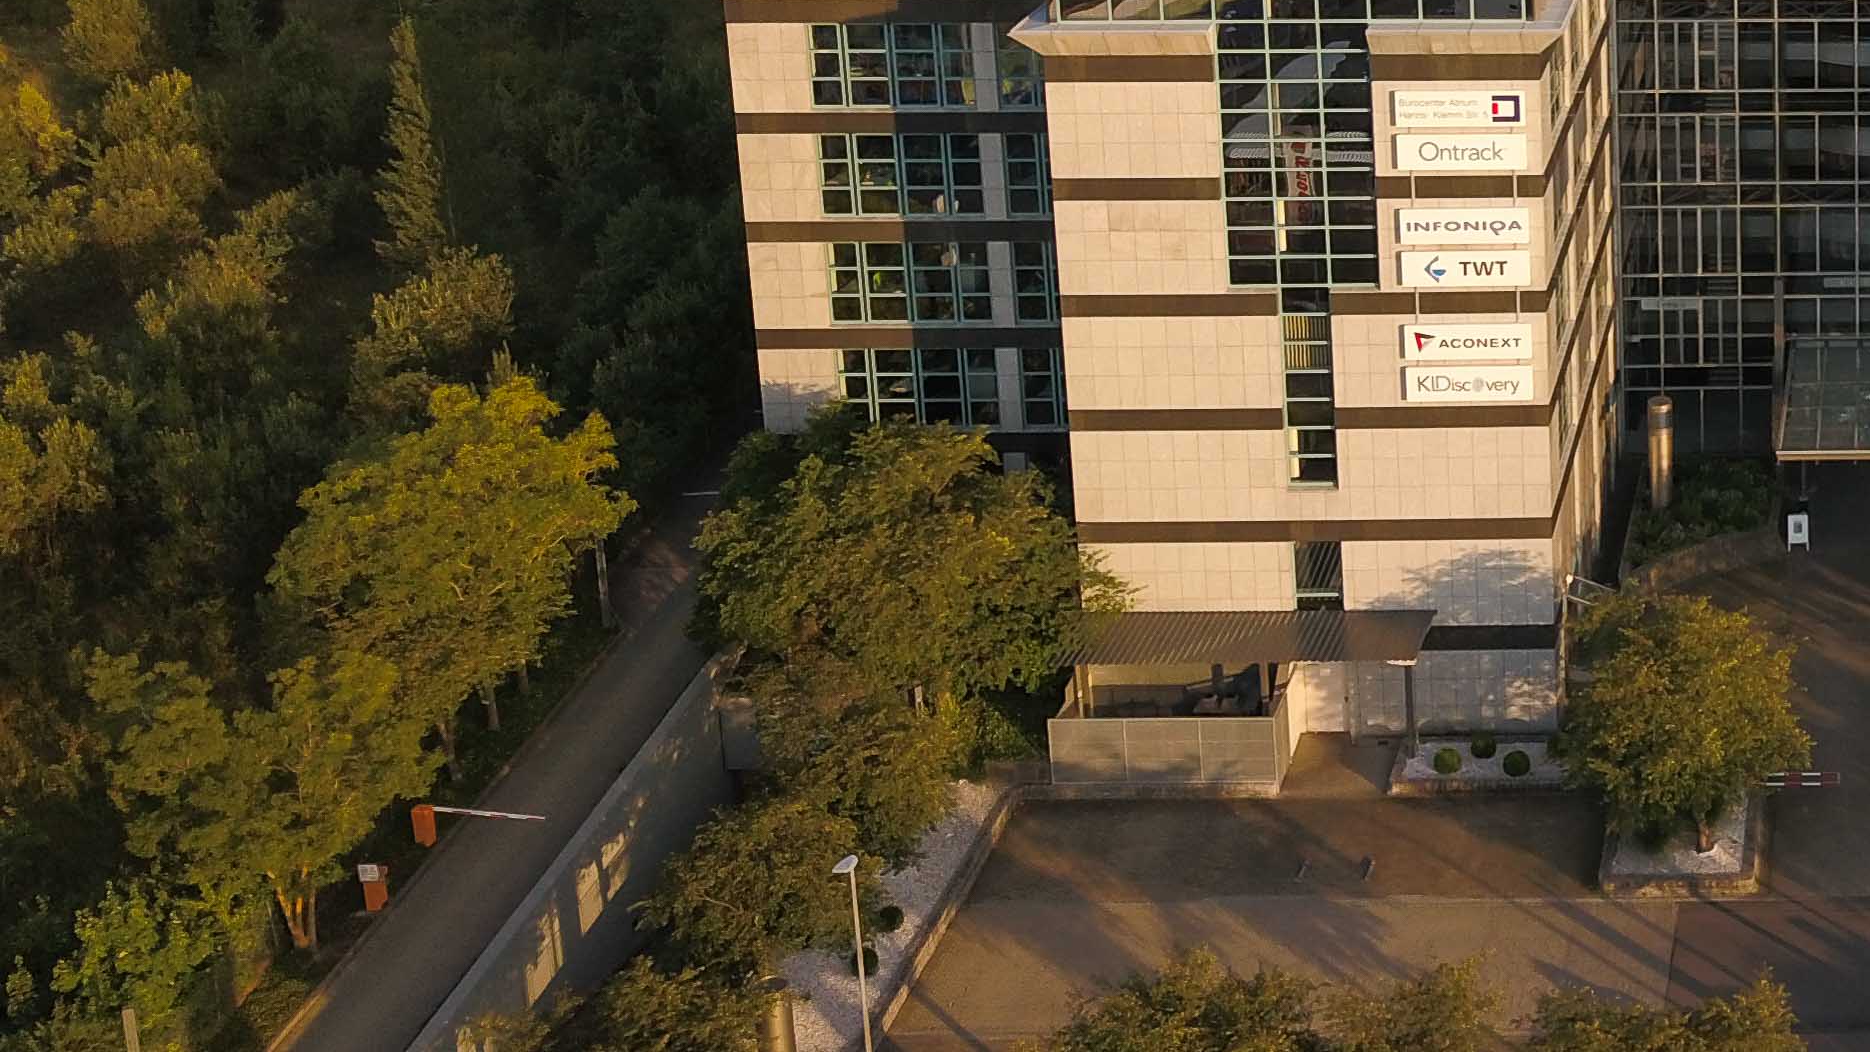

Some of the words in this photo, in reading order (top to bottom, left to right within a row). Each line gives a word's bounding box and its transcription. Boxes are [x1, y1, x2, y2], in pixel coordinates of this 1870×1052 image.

[1419, 140, 1504, 161] Ontrack
[1406, 220, 1522, 235] INFONIQA
[1458, 260, 1508, 276] TWT
[1439, 338, 1522, 349] ACONEXT
